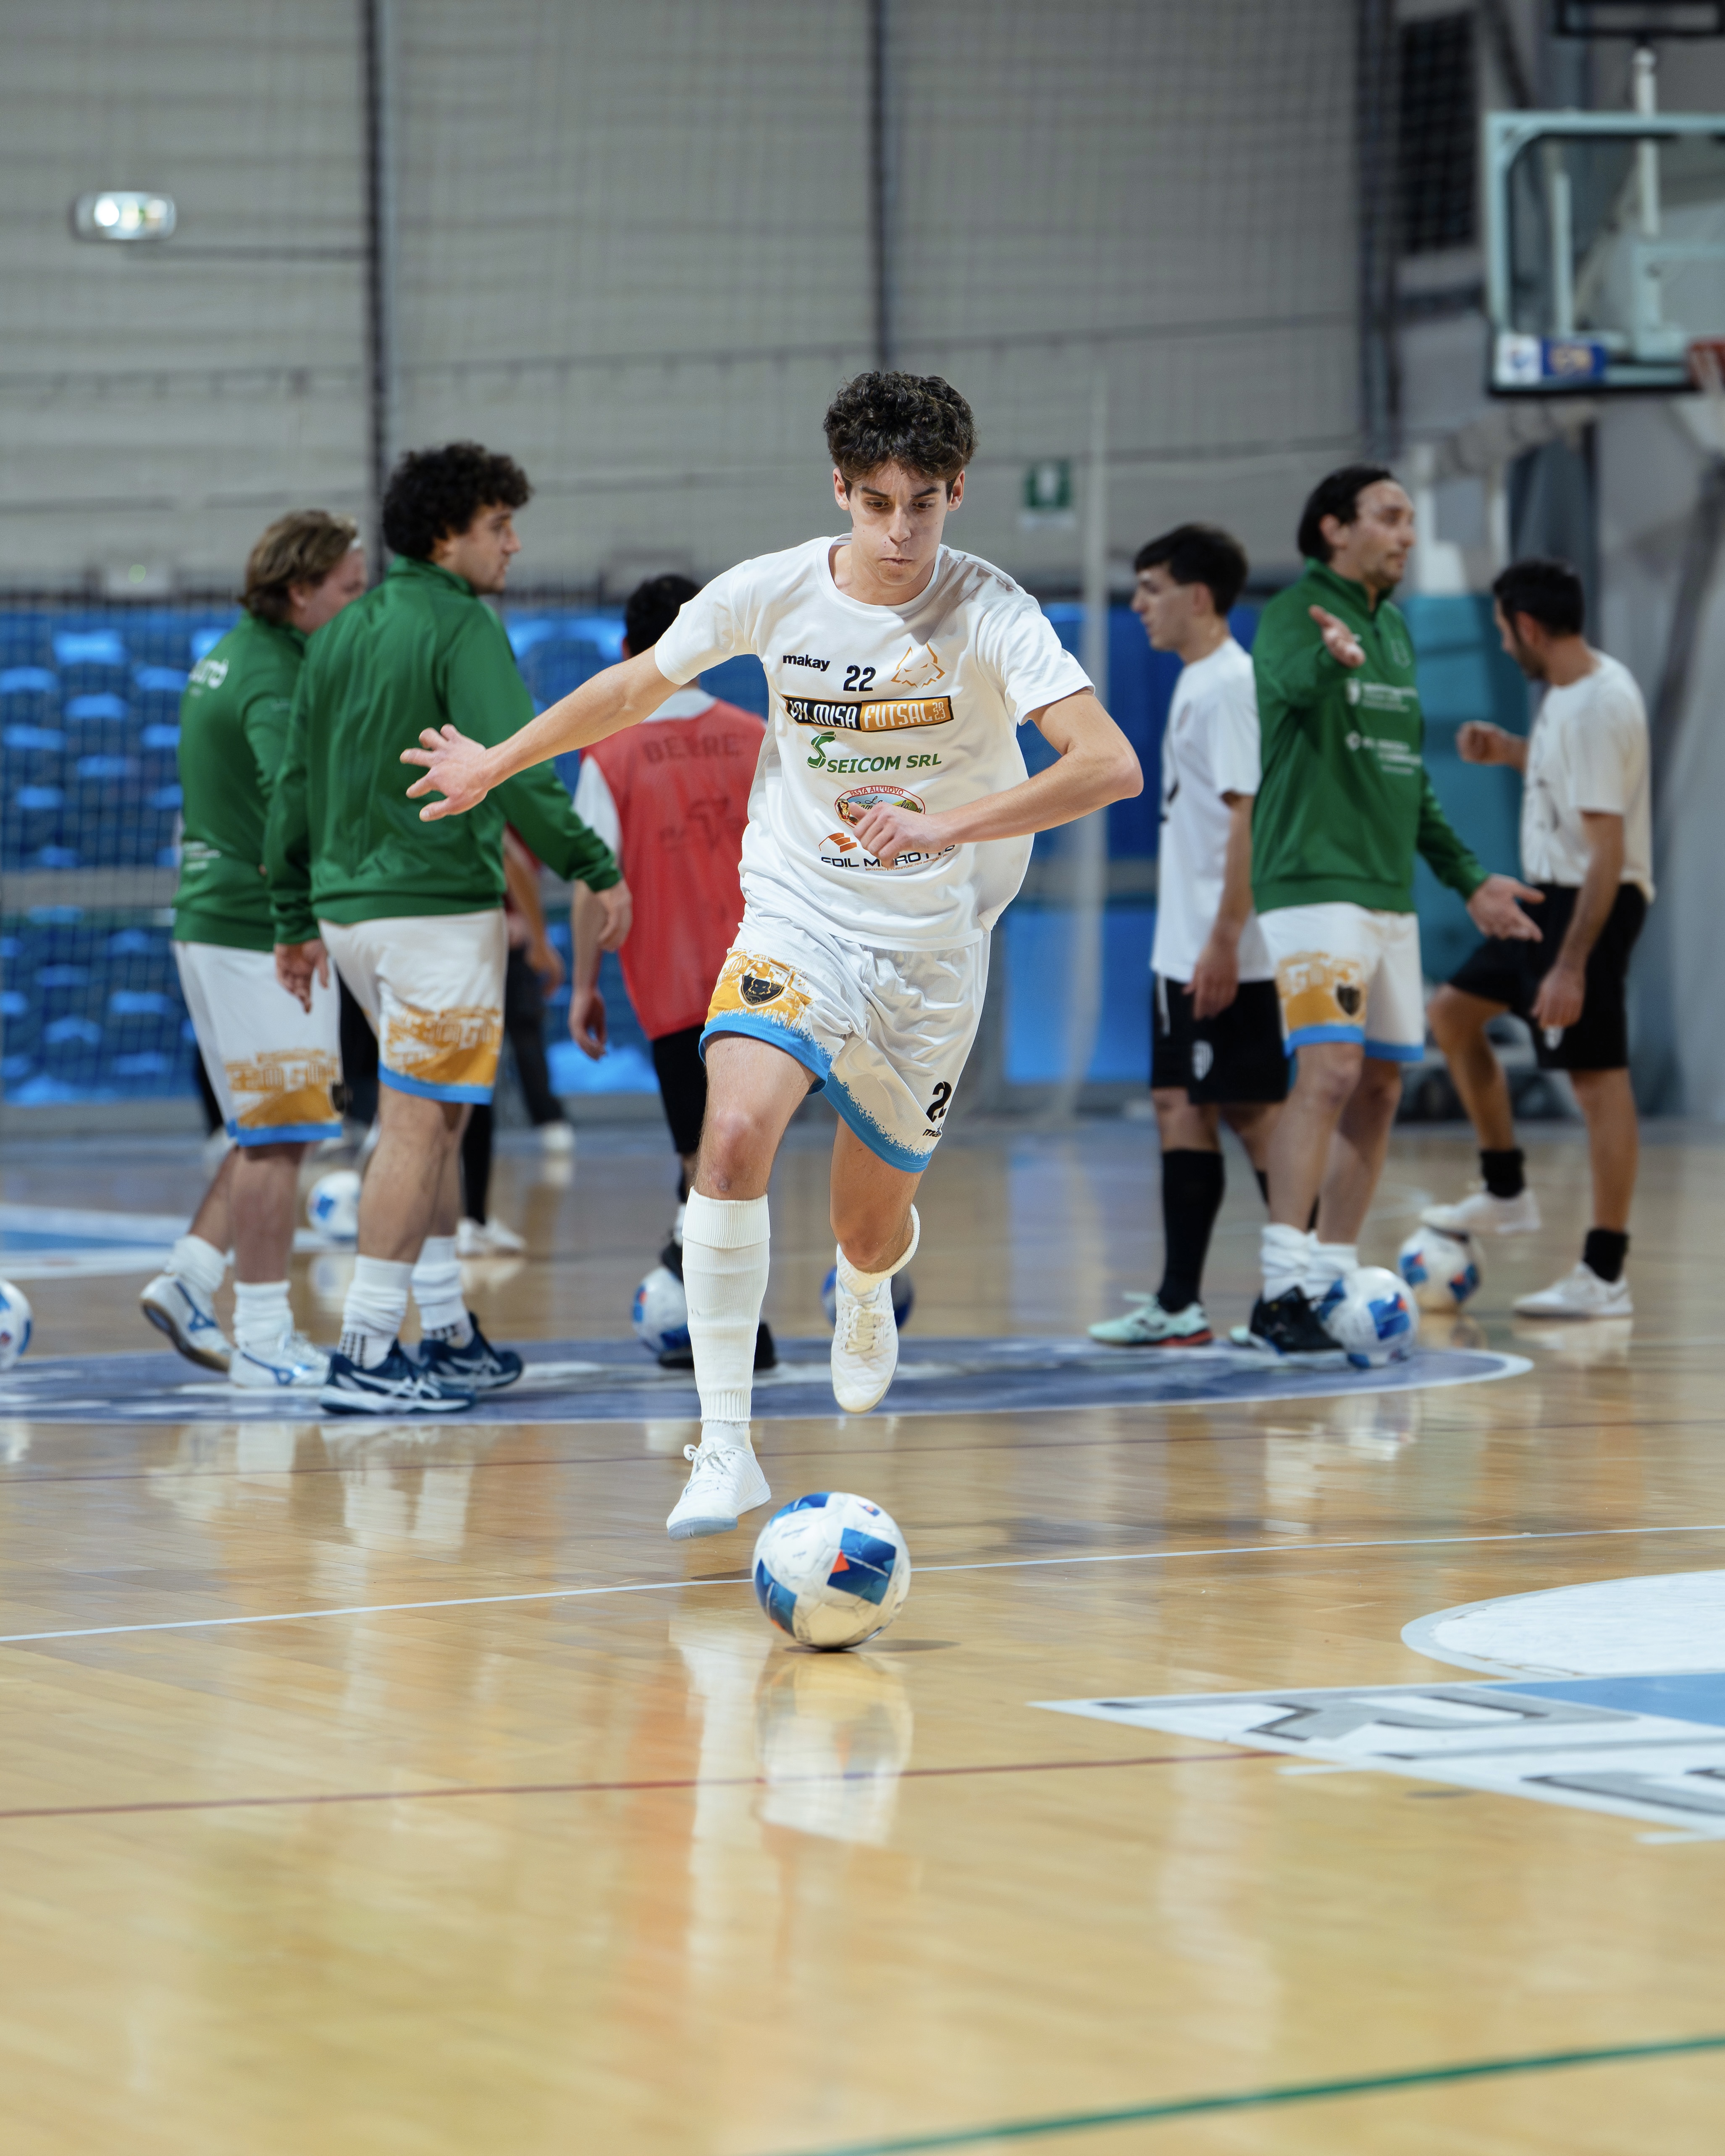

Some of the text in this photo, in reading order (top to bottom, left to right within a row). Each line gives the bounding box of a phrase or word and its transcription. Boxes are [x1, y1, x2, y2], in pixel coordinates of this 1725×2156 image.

[783, 654, 830, 671] makay
[843, 665, 876, 692] 22
[864, 703, 932, 729] FUTSAL
[827, 753, 942, 773] SEICOM SRL
[850, 787, 904, 796] PASTA ALL'UOVO
[821, 857, 859, 867] EDIL
